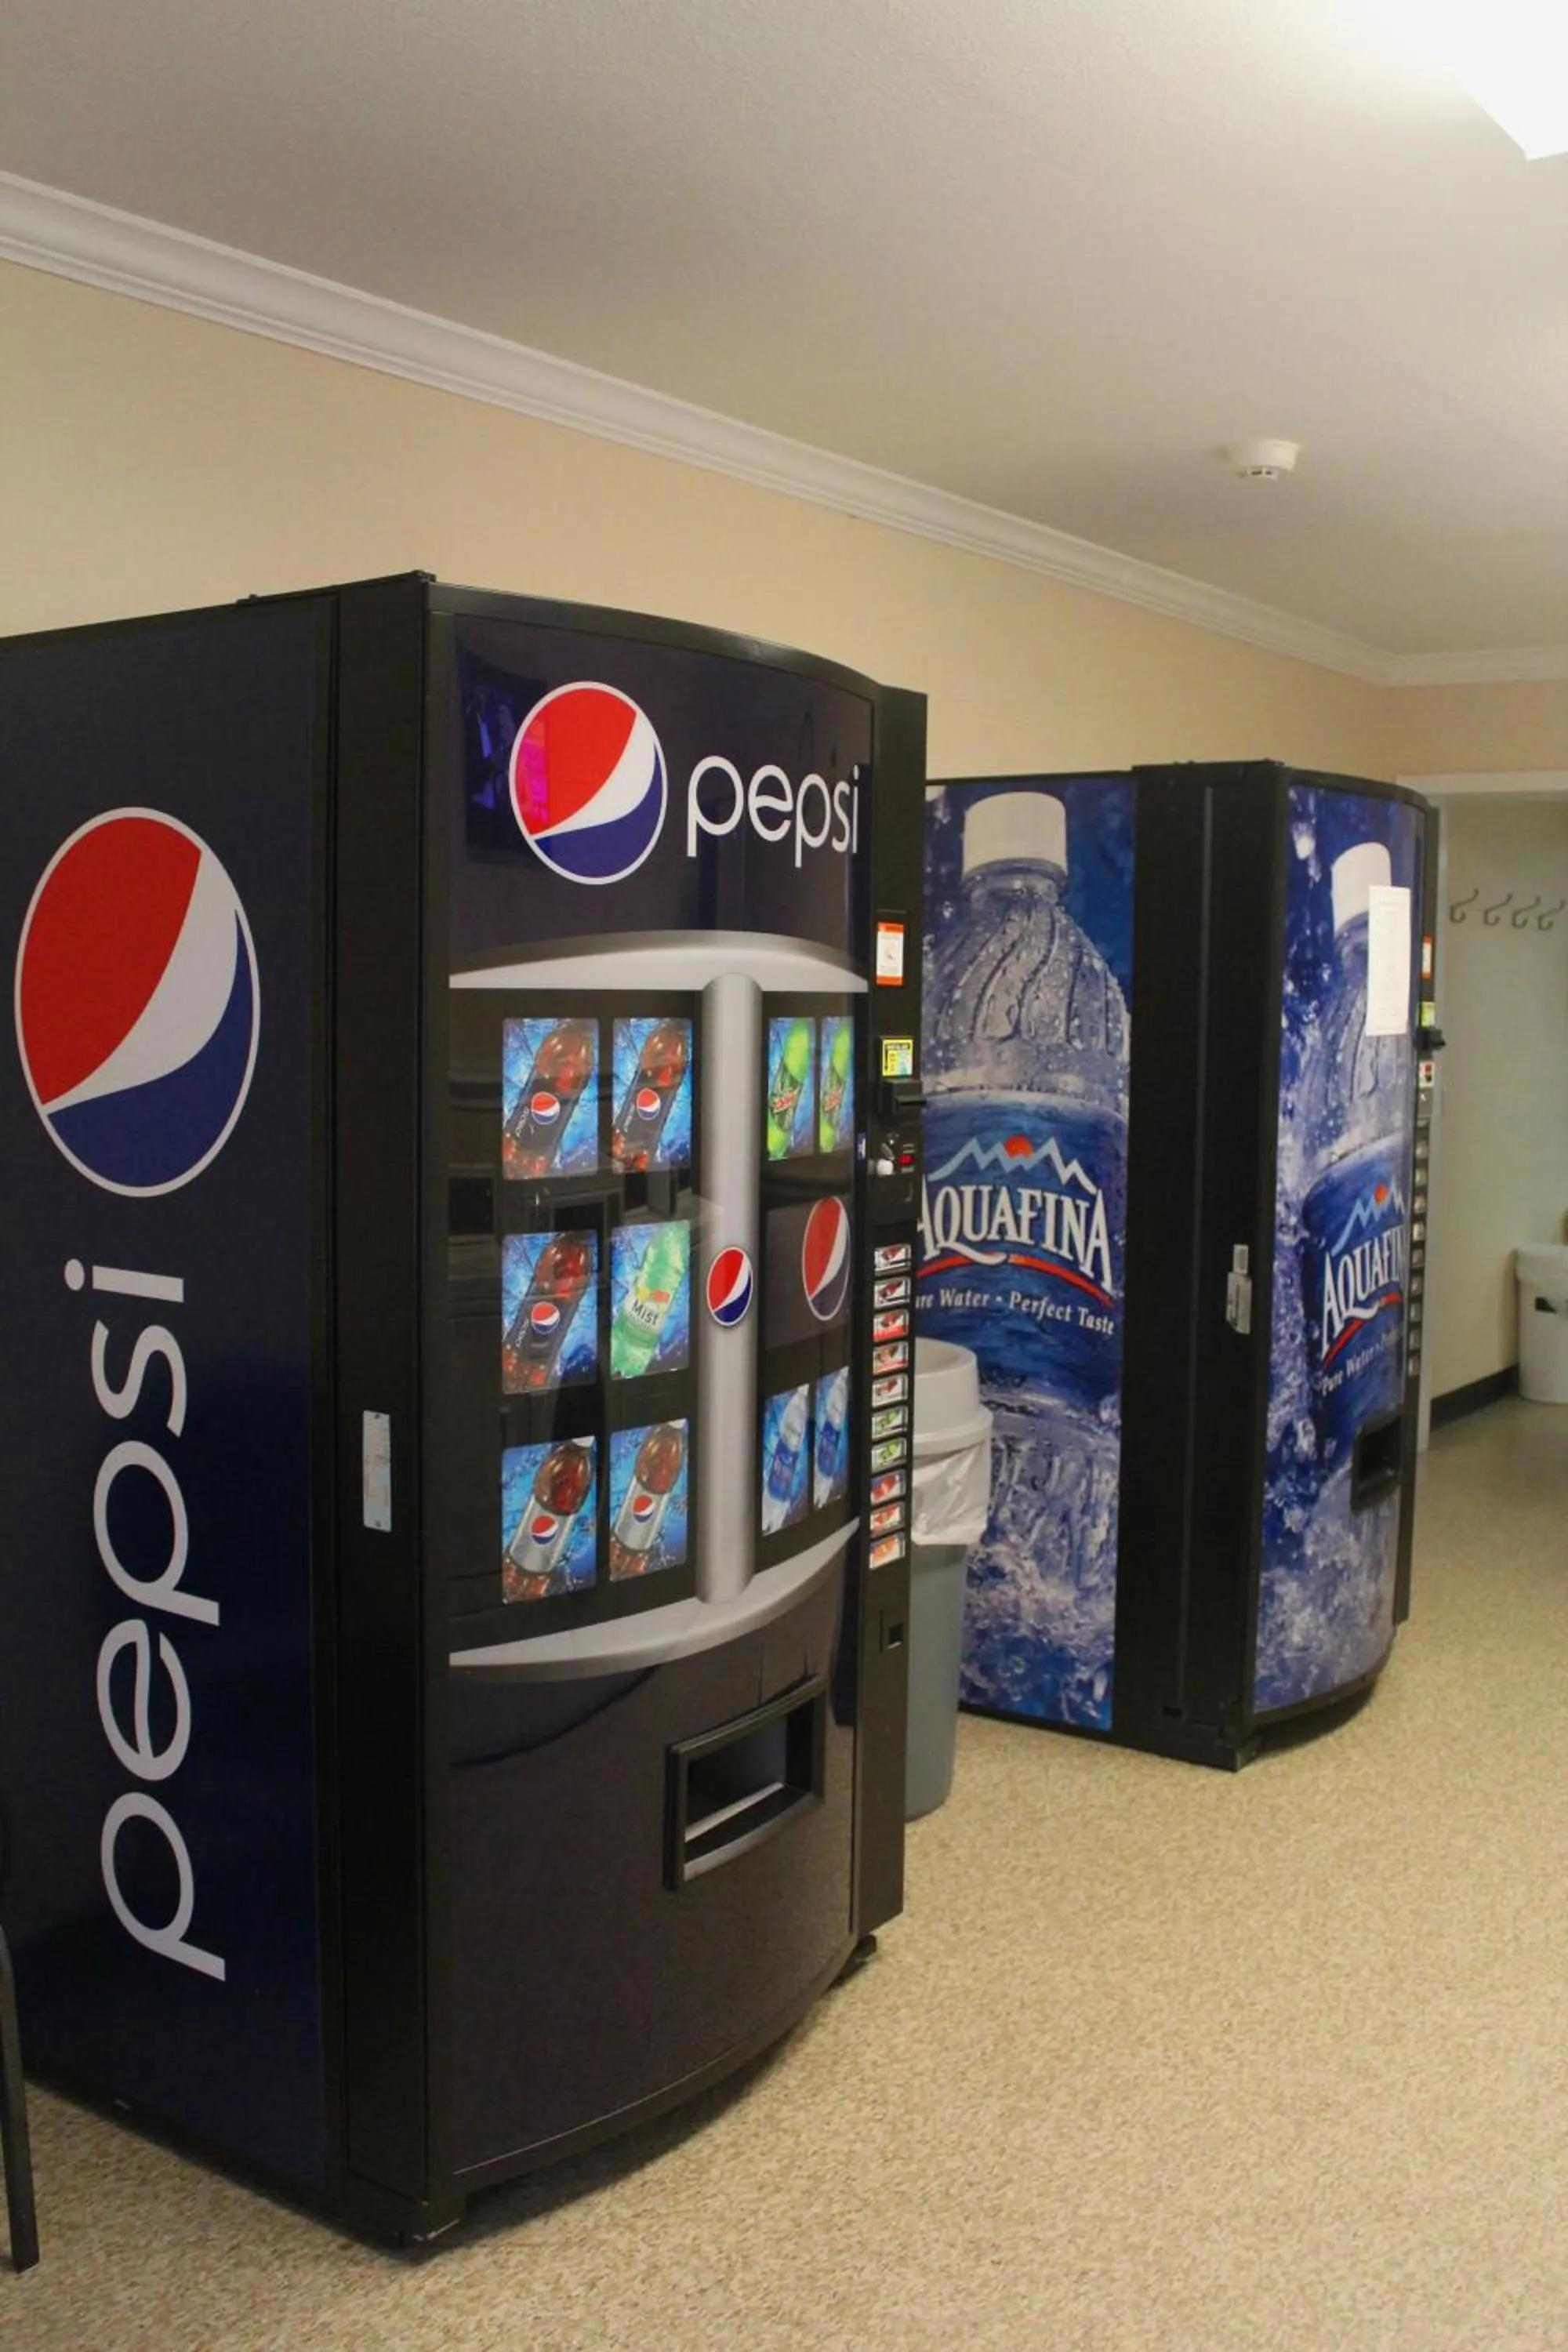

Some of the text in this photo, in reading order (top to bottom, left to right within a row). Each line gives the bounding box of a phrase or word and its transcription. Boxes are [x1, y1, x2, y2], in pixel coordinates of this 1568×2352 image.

[687, 755, 858, 868] pepsi
[917, 1174, 1112, 1293] AQUAFINA
[631, 1298, 659, 1325] Mist
[940, 1288, 989, 1308] Water
[1008, 1290, 1072, 1322] Perfect
[1078, 1306, 1114, 1334] Taste
[64, 1258, 225, 1981] pepsi
